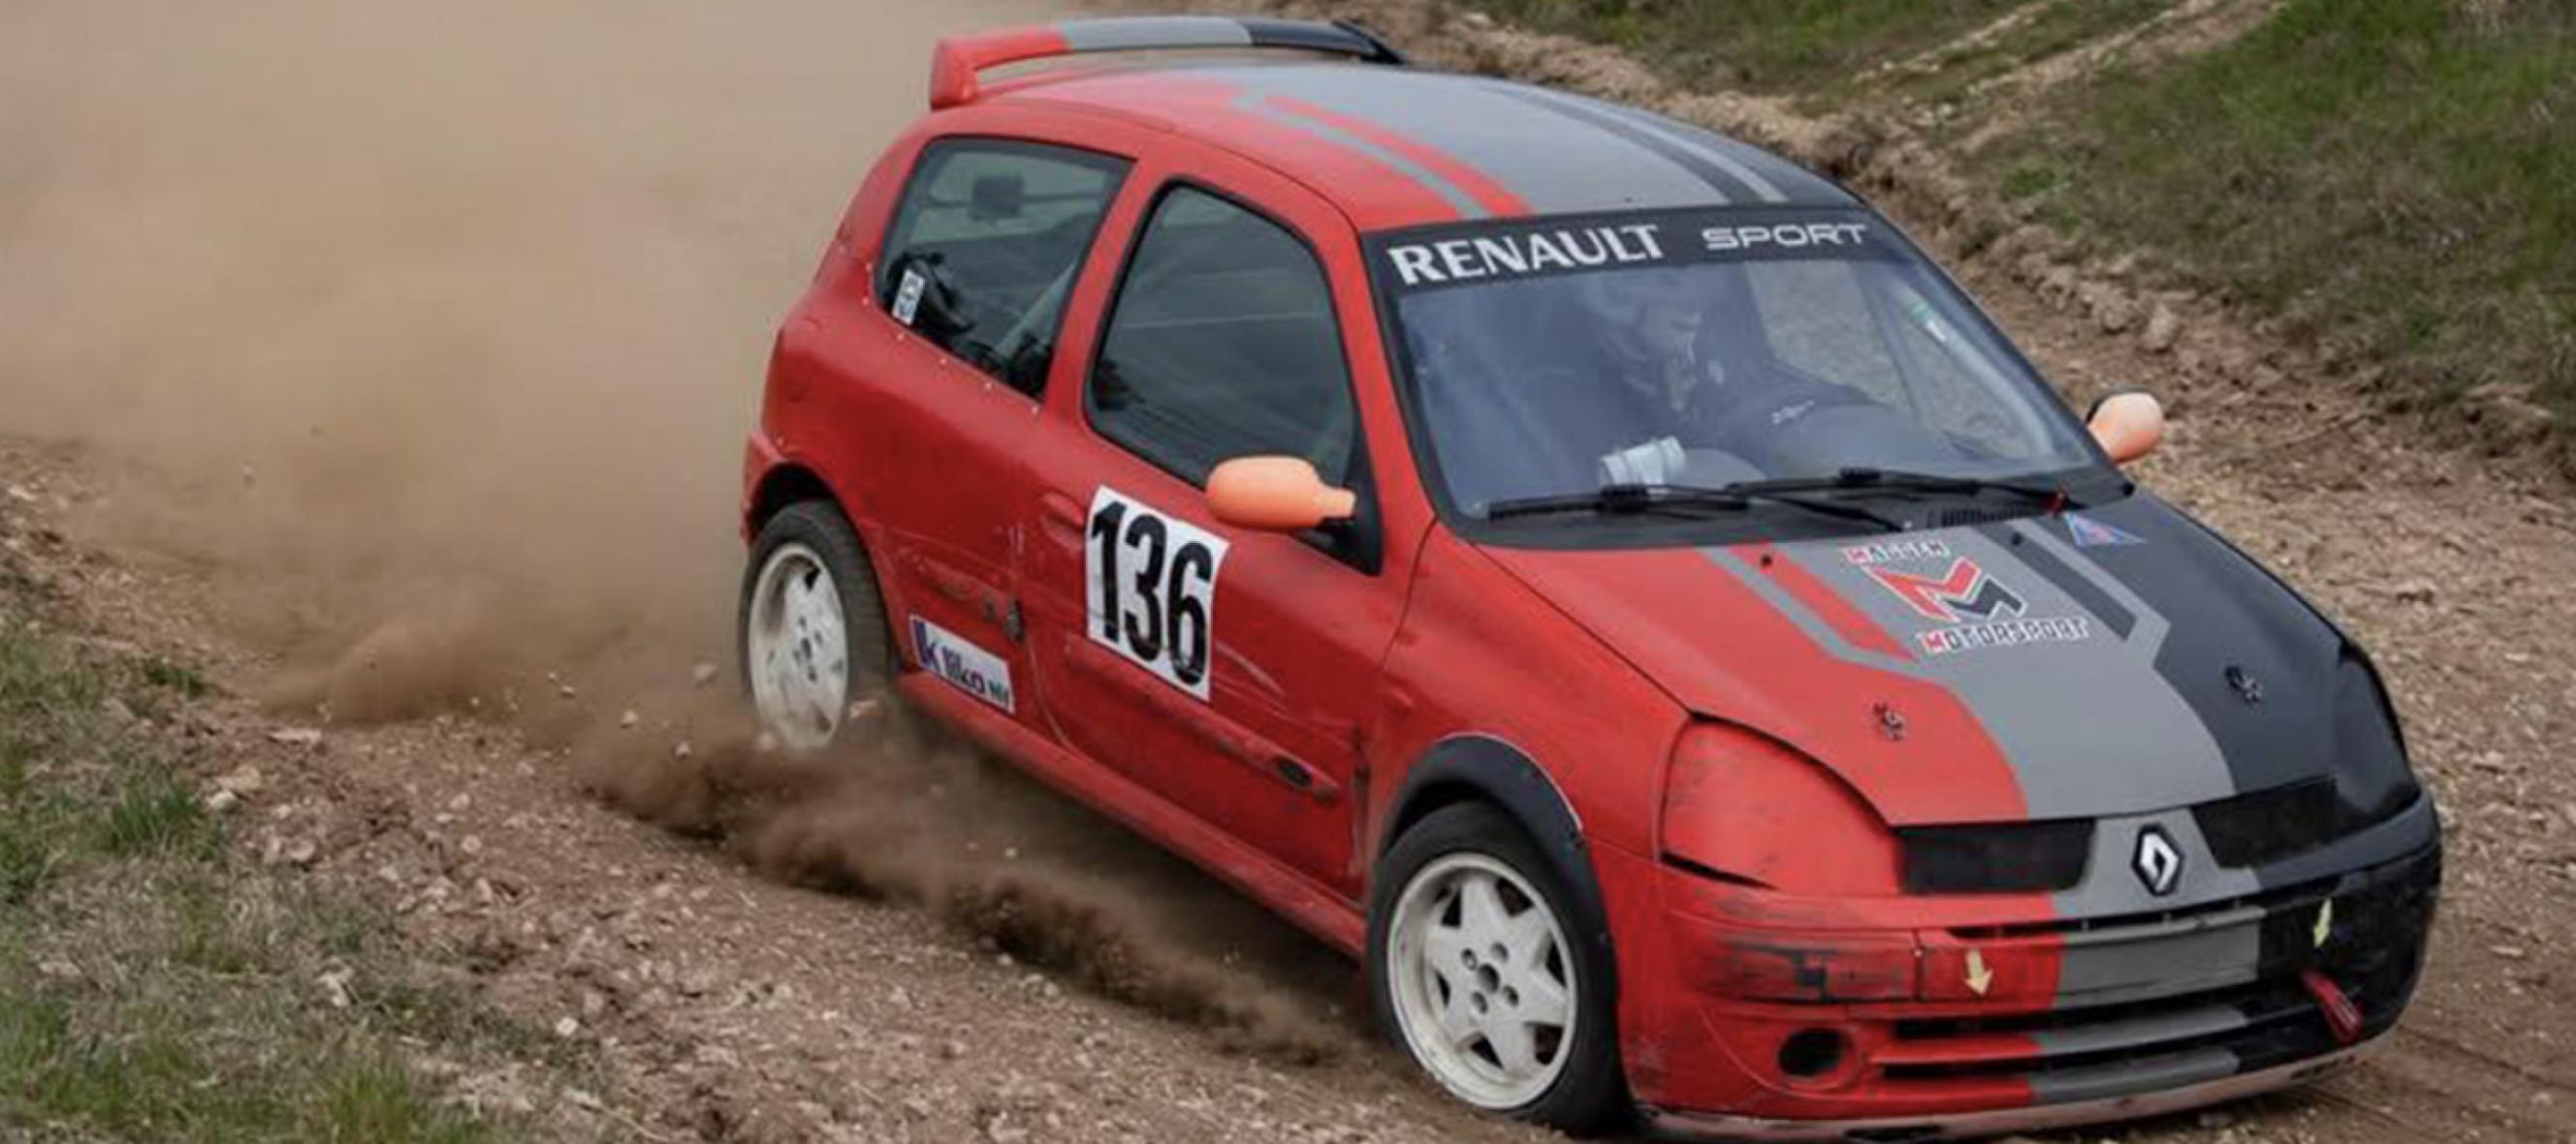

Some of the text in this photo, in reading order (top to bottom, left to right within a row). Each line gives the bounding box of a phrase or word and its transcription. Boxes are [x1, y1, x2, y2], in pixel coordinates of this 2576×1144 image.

[1386, 223, 1868, 286] RENAULT SPORT
[1092, 500, 1212, 685] 136
[1917, 618, 2088, 654] MOTORSPORT
